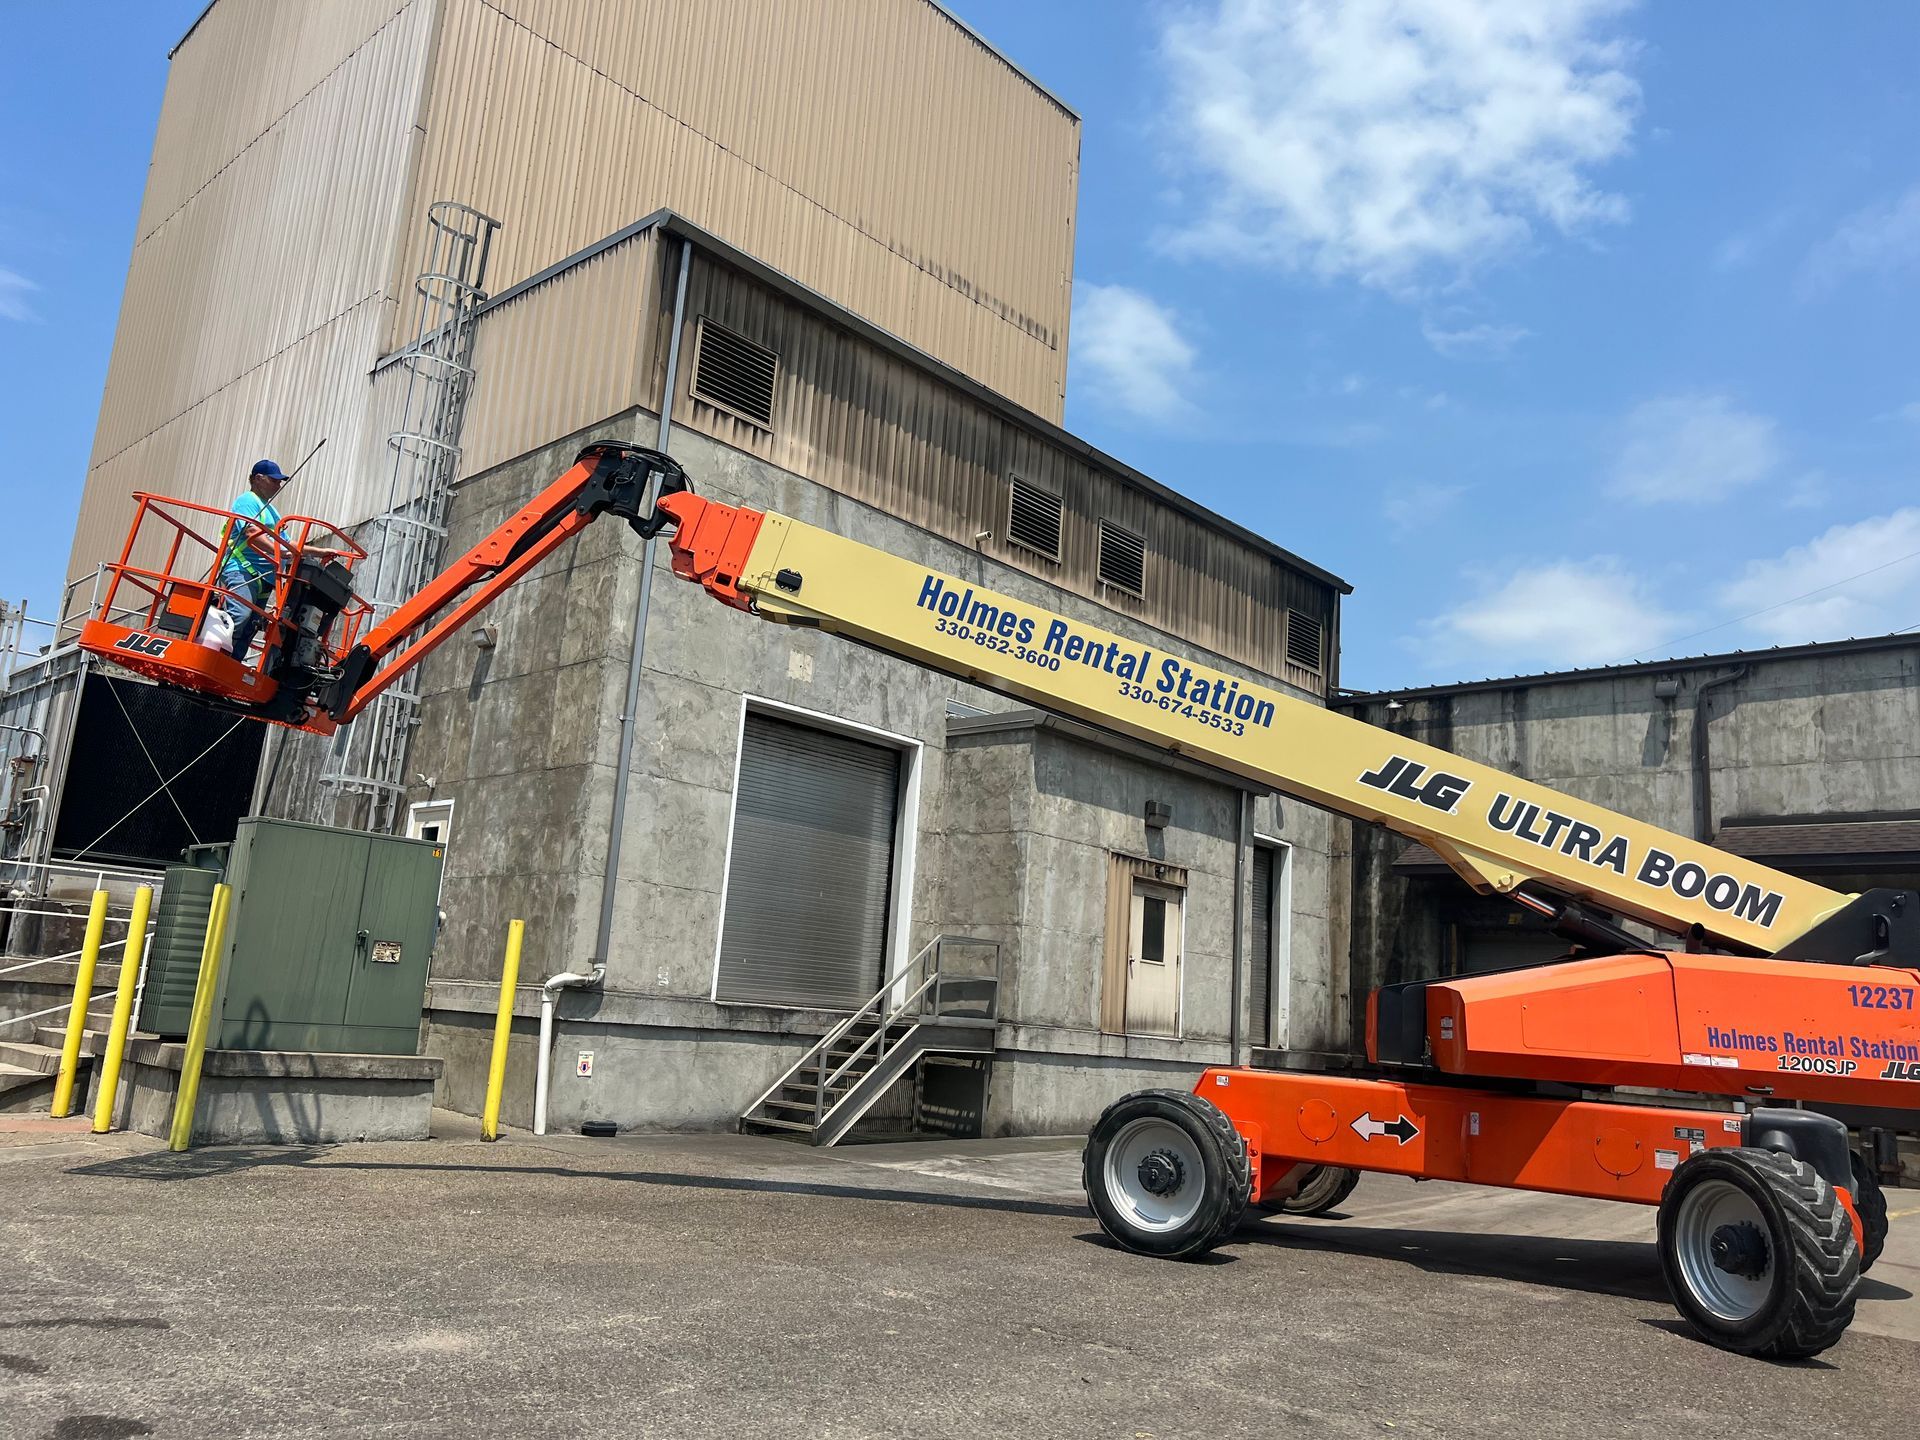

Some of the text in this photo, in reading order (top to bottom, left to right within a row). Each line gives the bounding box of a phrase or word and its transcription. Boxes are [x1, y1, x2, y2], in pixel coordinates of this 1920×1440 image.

[114, 632, 173, 657] JLG
[916, 574, 1275, 729] Holmes Rental Station
[934, 617, 1061, 672] 330-852-3600
[1118, 681, 1245, 737] 330-674-5533
[1357, 755, 1785, 929] JLG ULTRA BOOM
[1848, 985, 1914, 1010] 12237
[1707, 1027, 1919, 1061] Holmes Rental Station
[1777, 1055, 1857, 1076] 1200SJP
